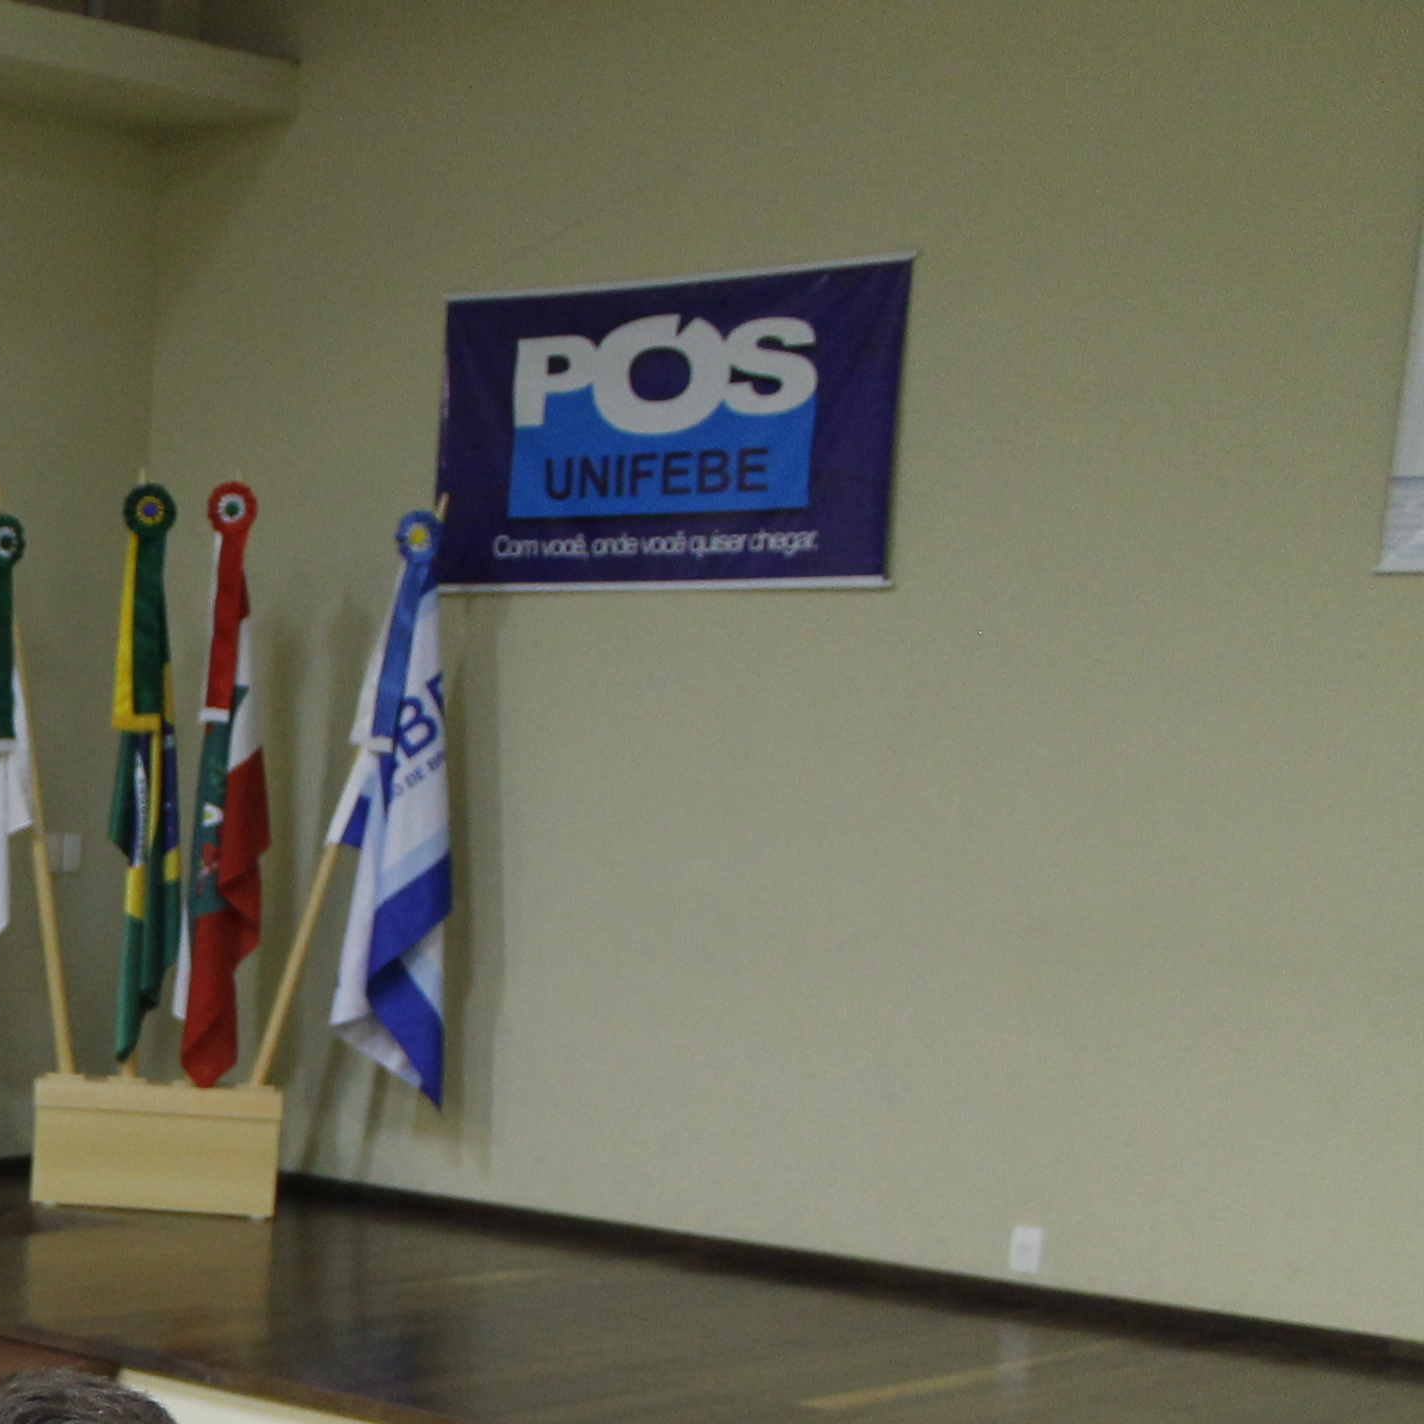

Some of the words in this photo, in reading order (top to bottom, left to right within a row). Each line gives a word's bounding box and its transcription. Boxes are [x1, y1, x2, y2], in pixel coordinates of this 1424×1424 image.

[545, 447, 769, 500] UNIFEBE
[493, 536, 539, 557] Com
[591, 534, 638, 556] onde
